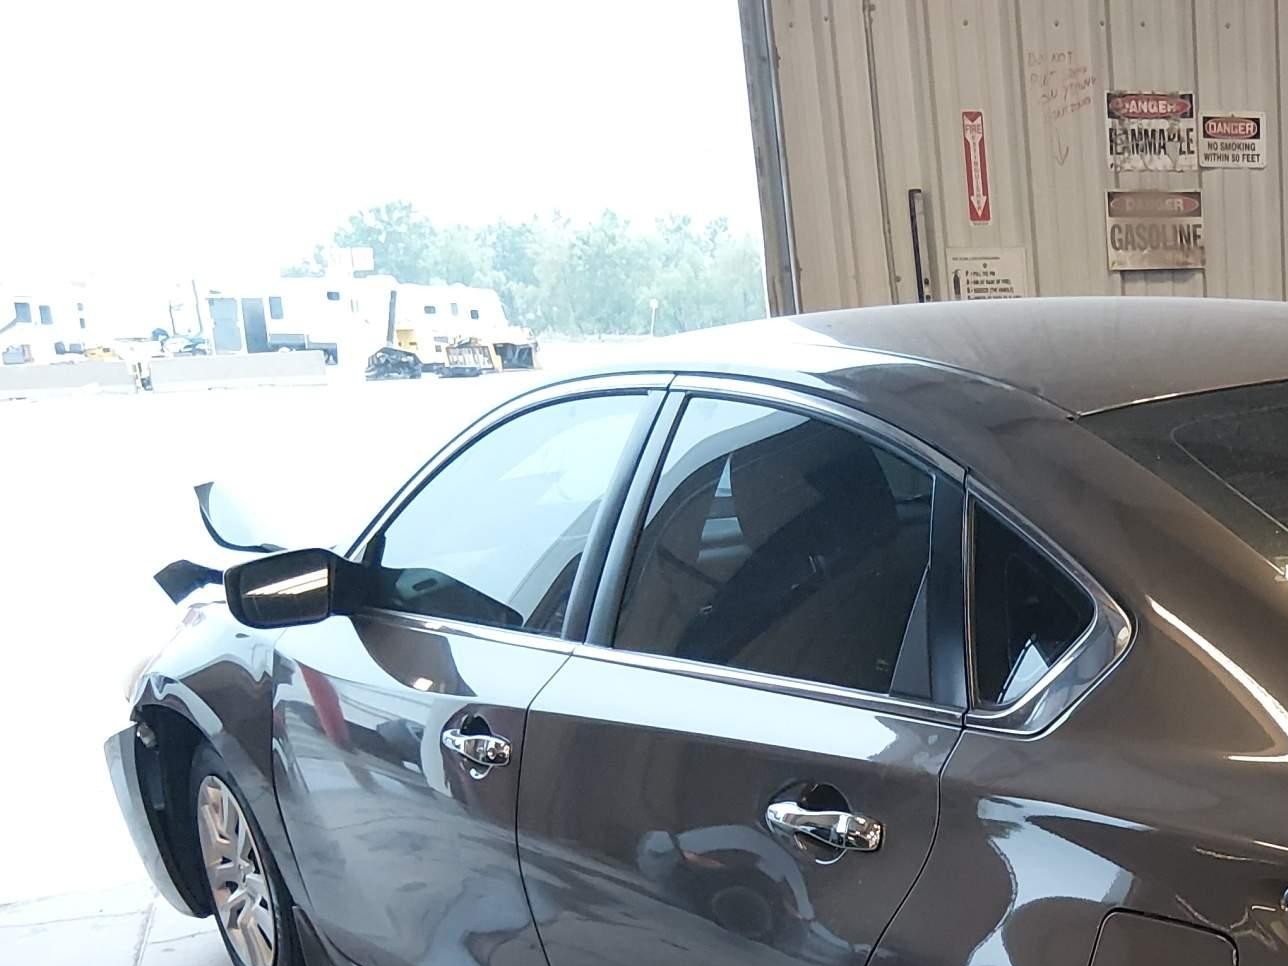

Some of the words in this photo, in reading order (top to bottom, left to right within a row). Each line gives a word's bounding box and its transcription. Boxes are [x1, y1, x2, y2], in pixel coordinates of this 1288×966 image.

[964, 124, 982, 135] FIRE
[1208, 122, 1254, 135] DANGER
[1207, 141, 1218, 151] NO
[1220, 141, 1256, 151] SMOKING
[1204, 153, 1230, 163] WITHIN
[1231, 153, 1240, 162] 50
[1242, 153, 1261, 163] FEET
[1110, 223, 1203, 251] GASOLINE
